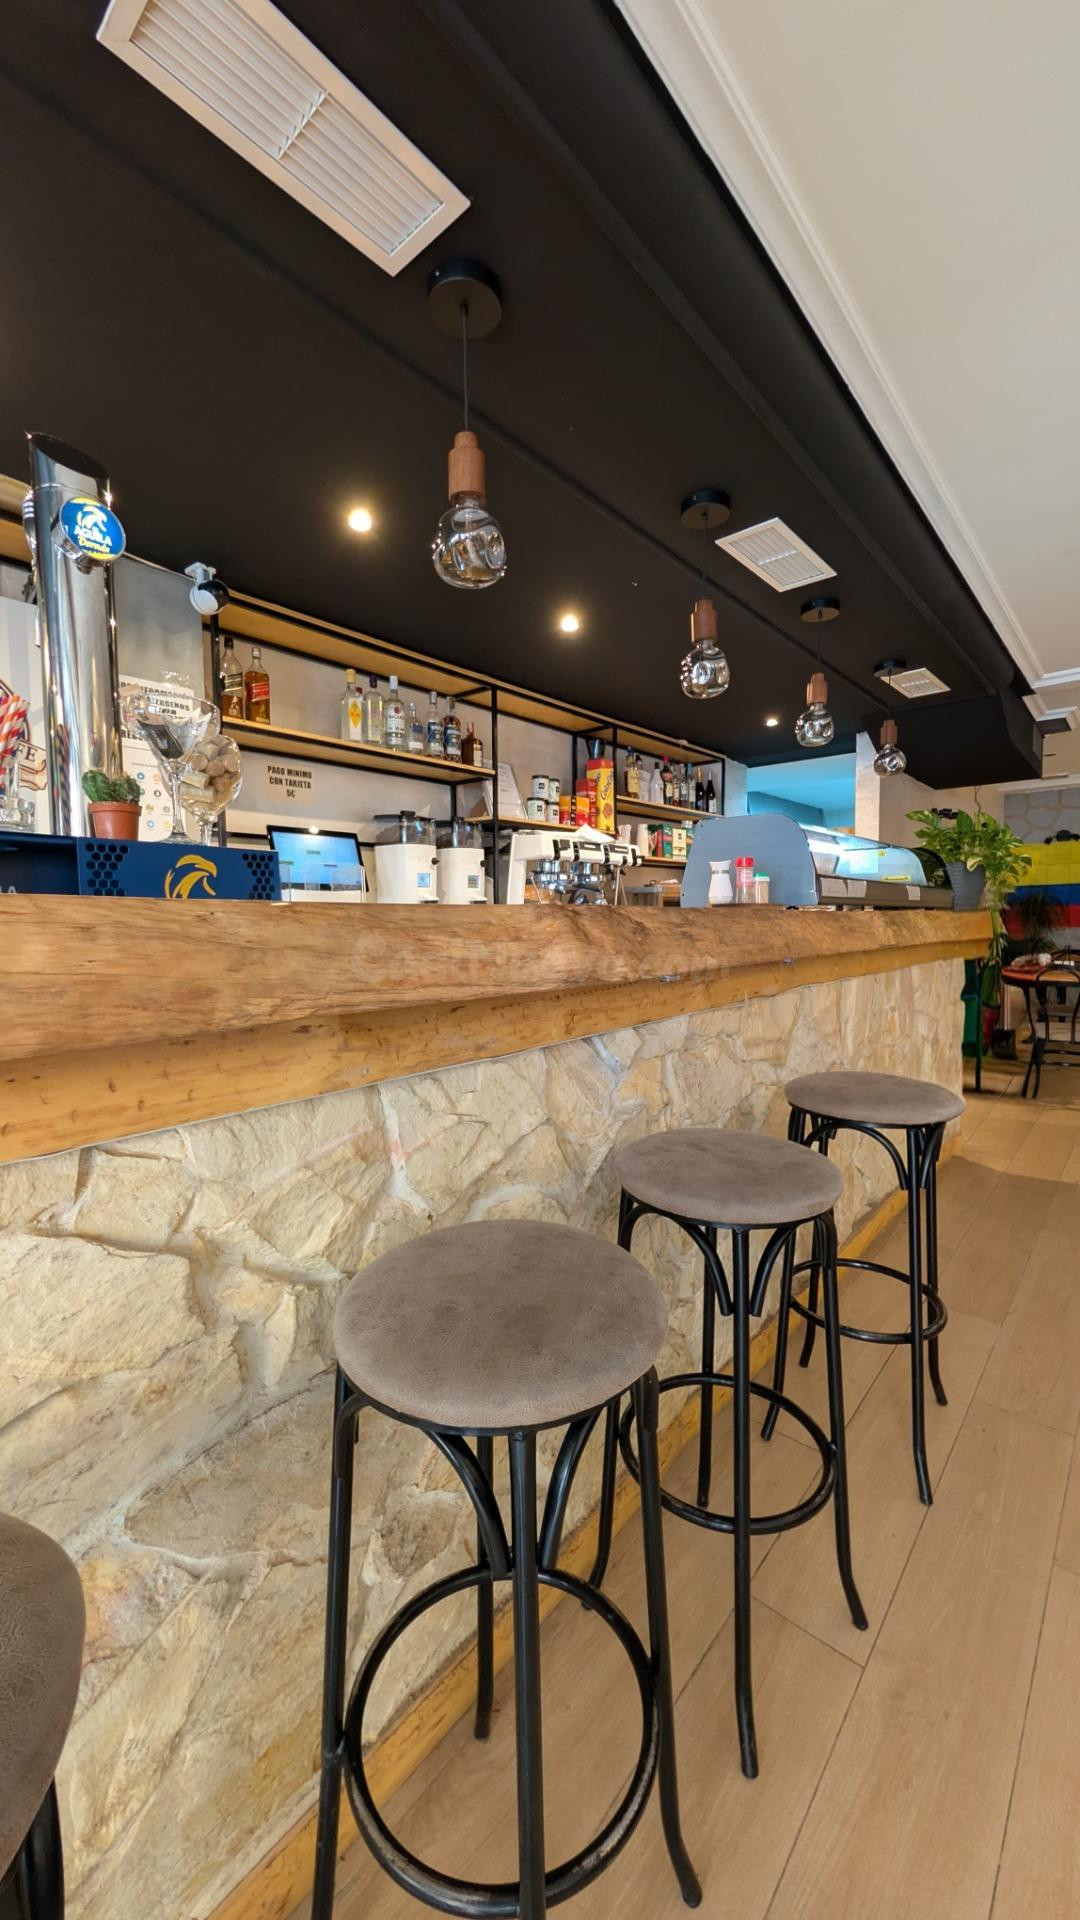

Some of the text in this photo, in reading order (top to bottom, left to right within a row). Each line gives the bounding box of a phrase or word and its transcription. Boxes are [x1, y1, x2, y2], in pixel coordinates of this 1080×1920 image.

[267, 765, 312, 779] PAGO MINIMO
[269, 776, 312, 789] CON TARJETA
